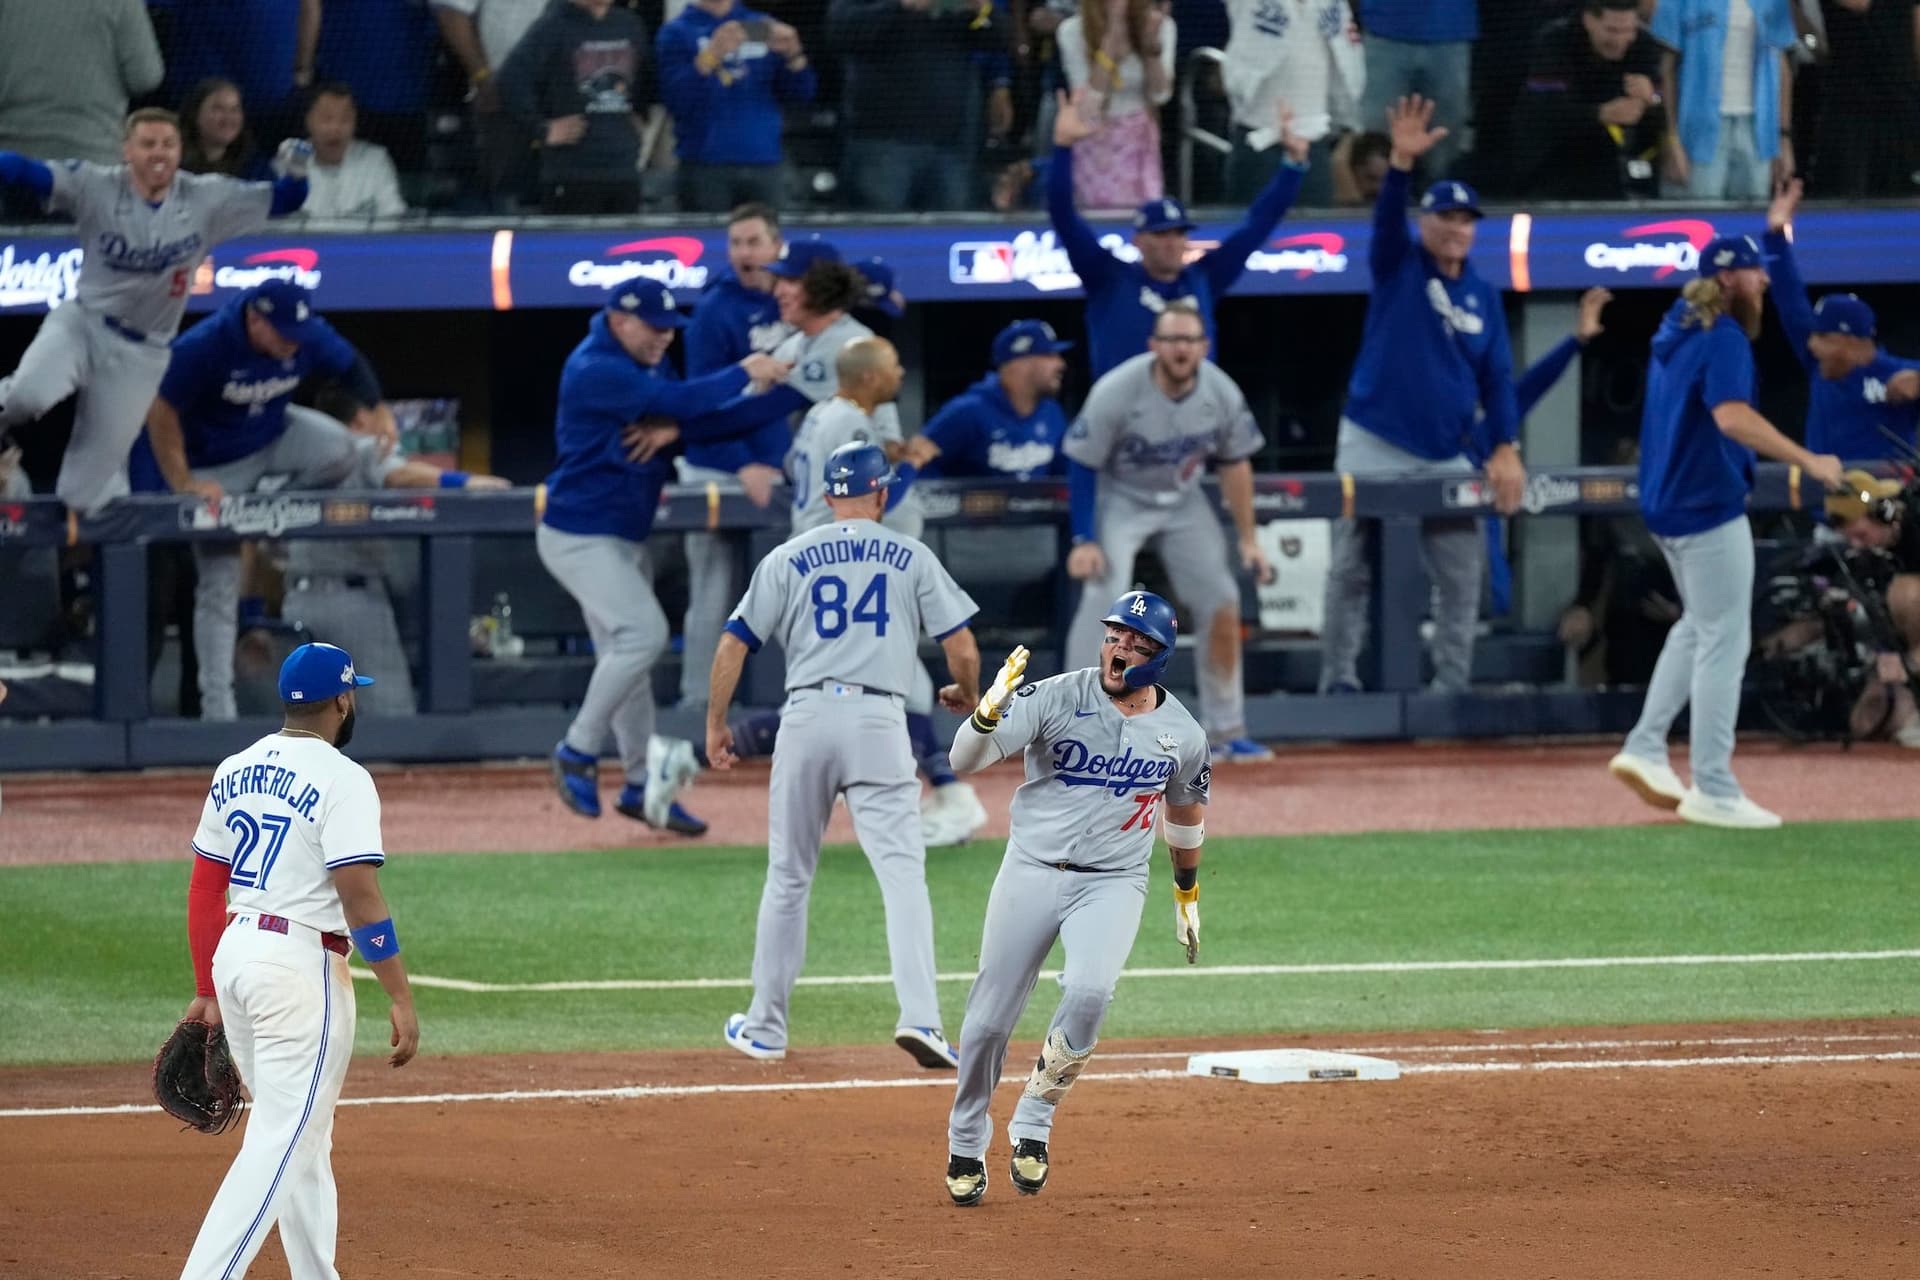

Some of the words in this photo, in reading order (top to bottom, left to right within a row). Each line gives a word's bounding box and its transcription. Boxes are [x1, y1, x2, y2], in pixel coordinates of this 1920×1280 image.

[168, 266, 191, 299] 5
[834, 483, 849, 496] 84
[789, 539, 913, 577] WOODWARD
[811, 573, 890, 639] 84
[1130, 595, 1147, 617] LA
[1053, 739, 1176, 797] Dodgers
[210, 765, 296, 813] GUERRERO
[287, 781, 321, 823] JR.
[225, 809, 291, 891] 27
